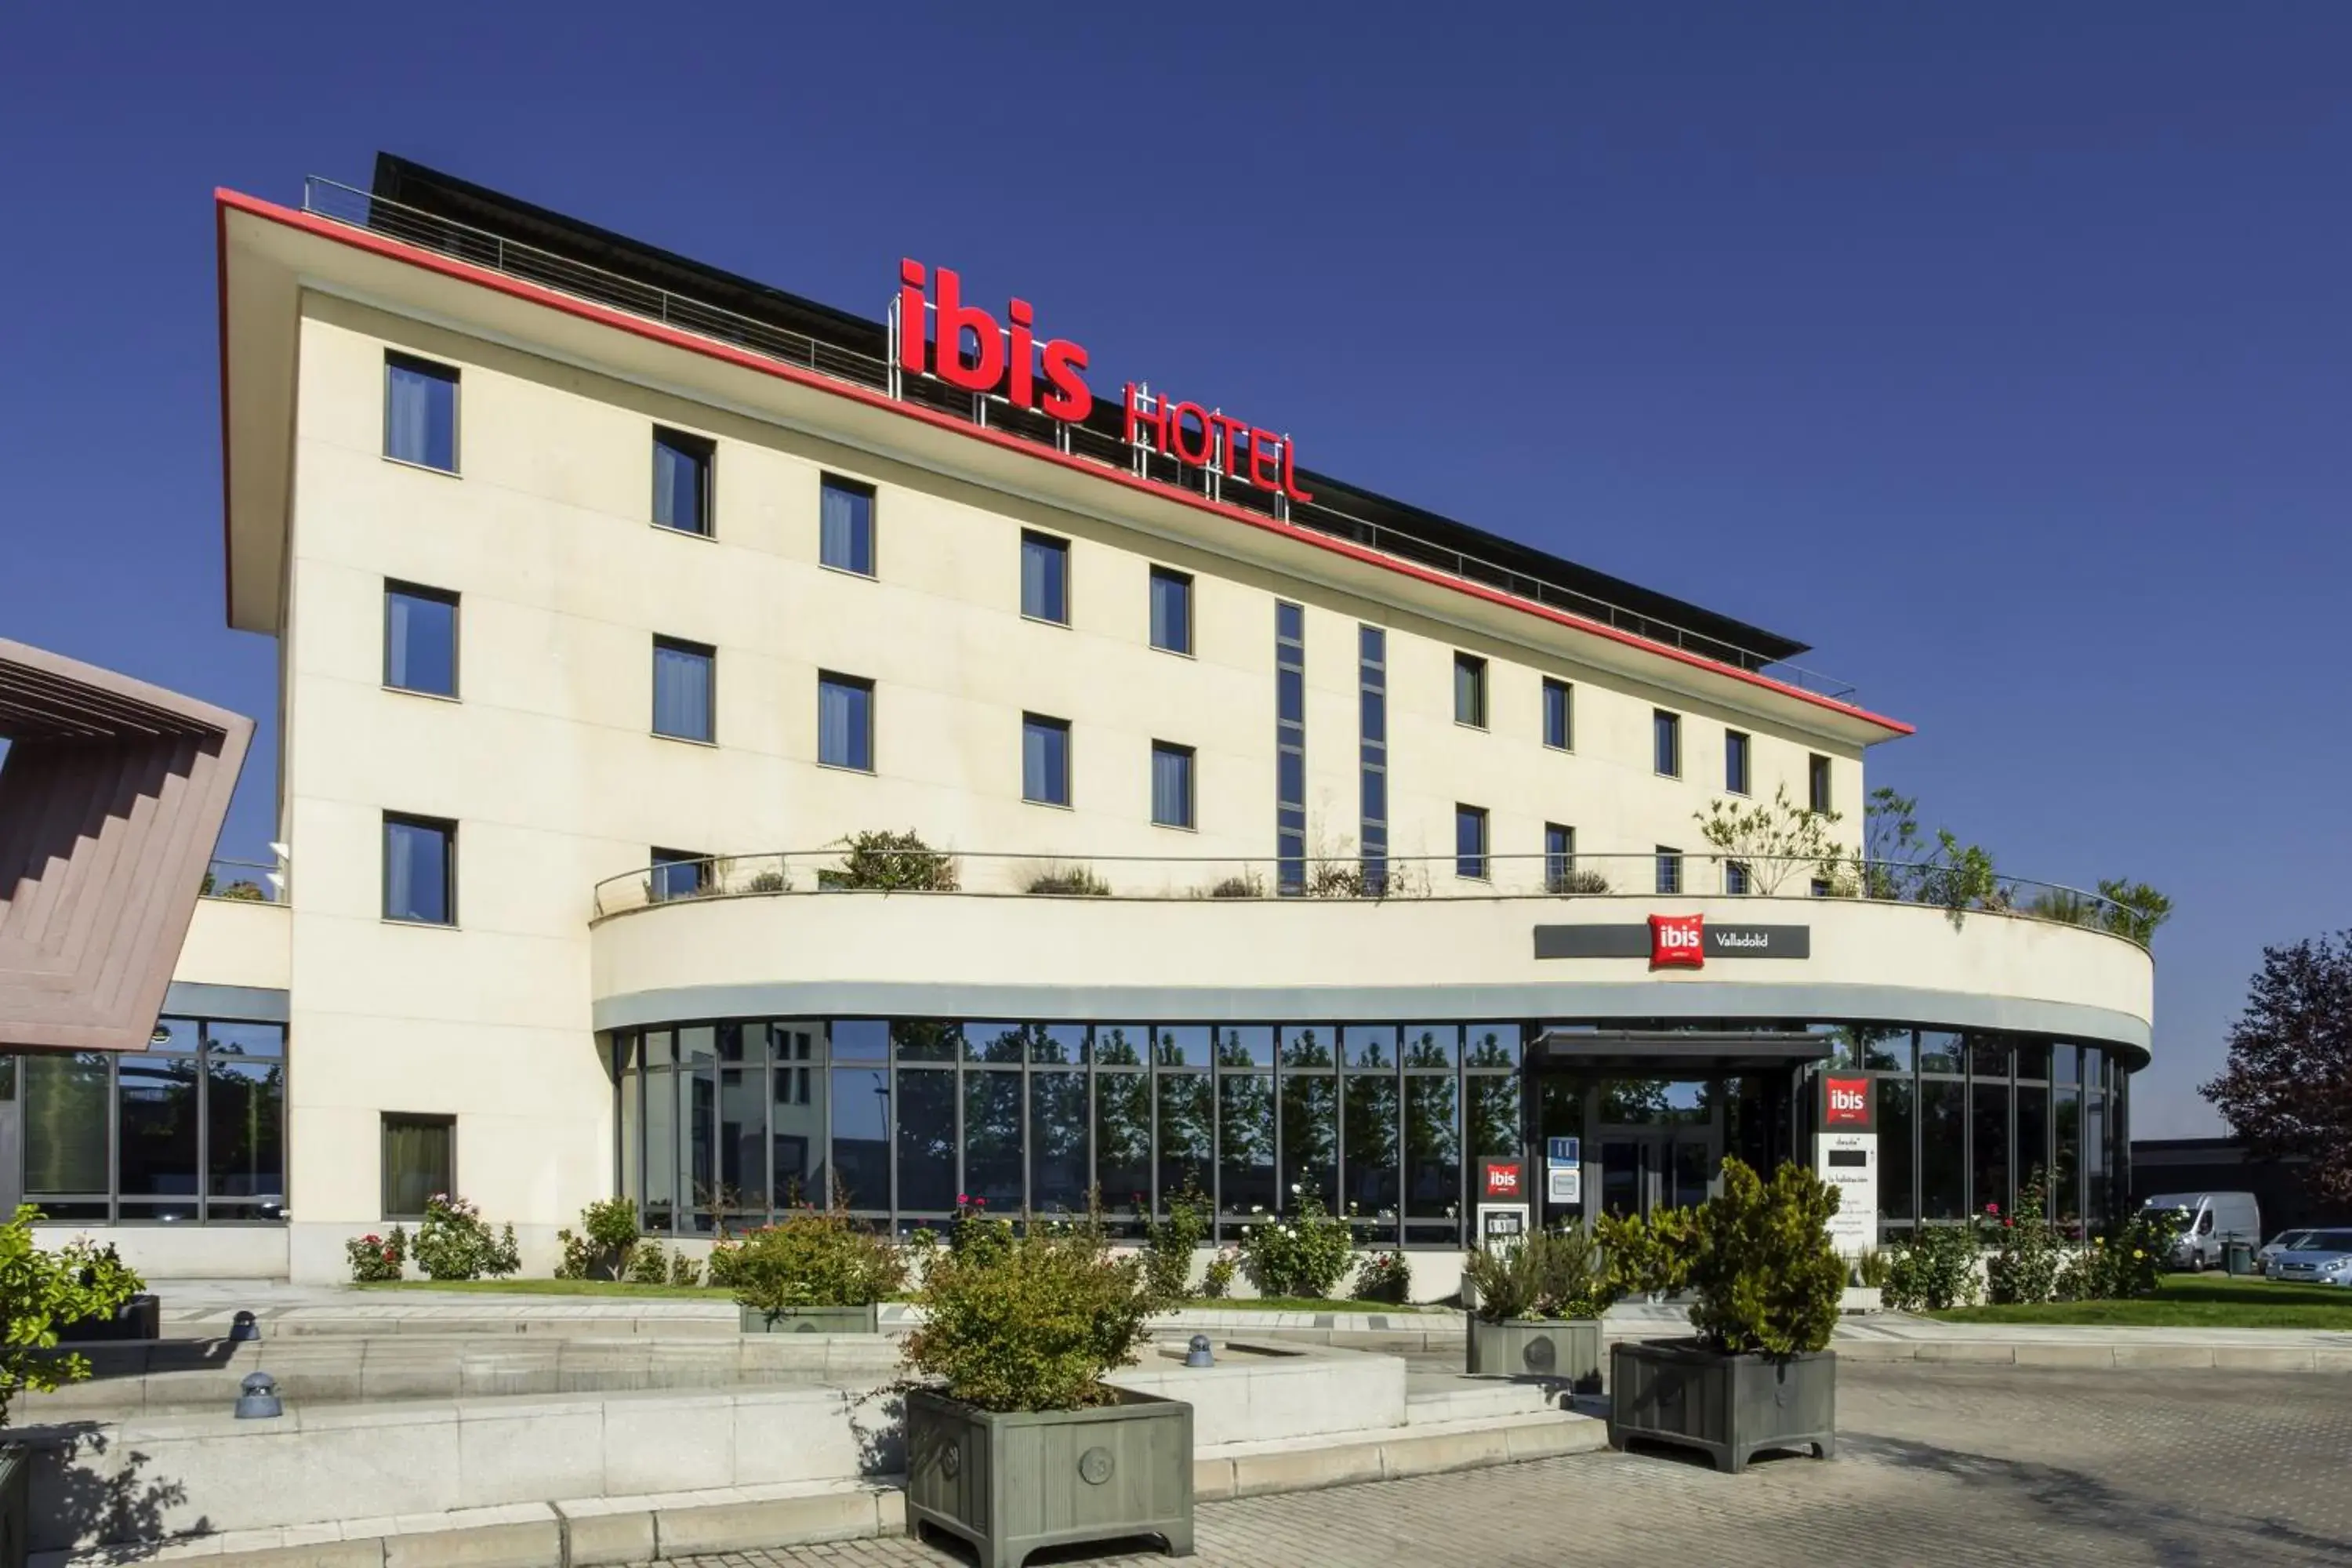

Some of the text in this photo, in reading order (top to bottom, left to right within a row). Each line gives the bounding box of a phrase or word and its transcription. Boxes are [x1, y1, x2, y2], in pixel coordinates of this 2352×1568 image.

[900, 257, 1314, 503] ibis HOTEL
[1661, 925, 1700, 948] ibis
[1716, 932, 1768, 946] Valladolid
[1831, 1089, 1864, 1109] ibis
[1490, 1171, 1516, 1186] ibis
